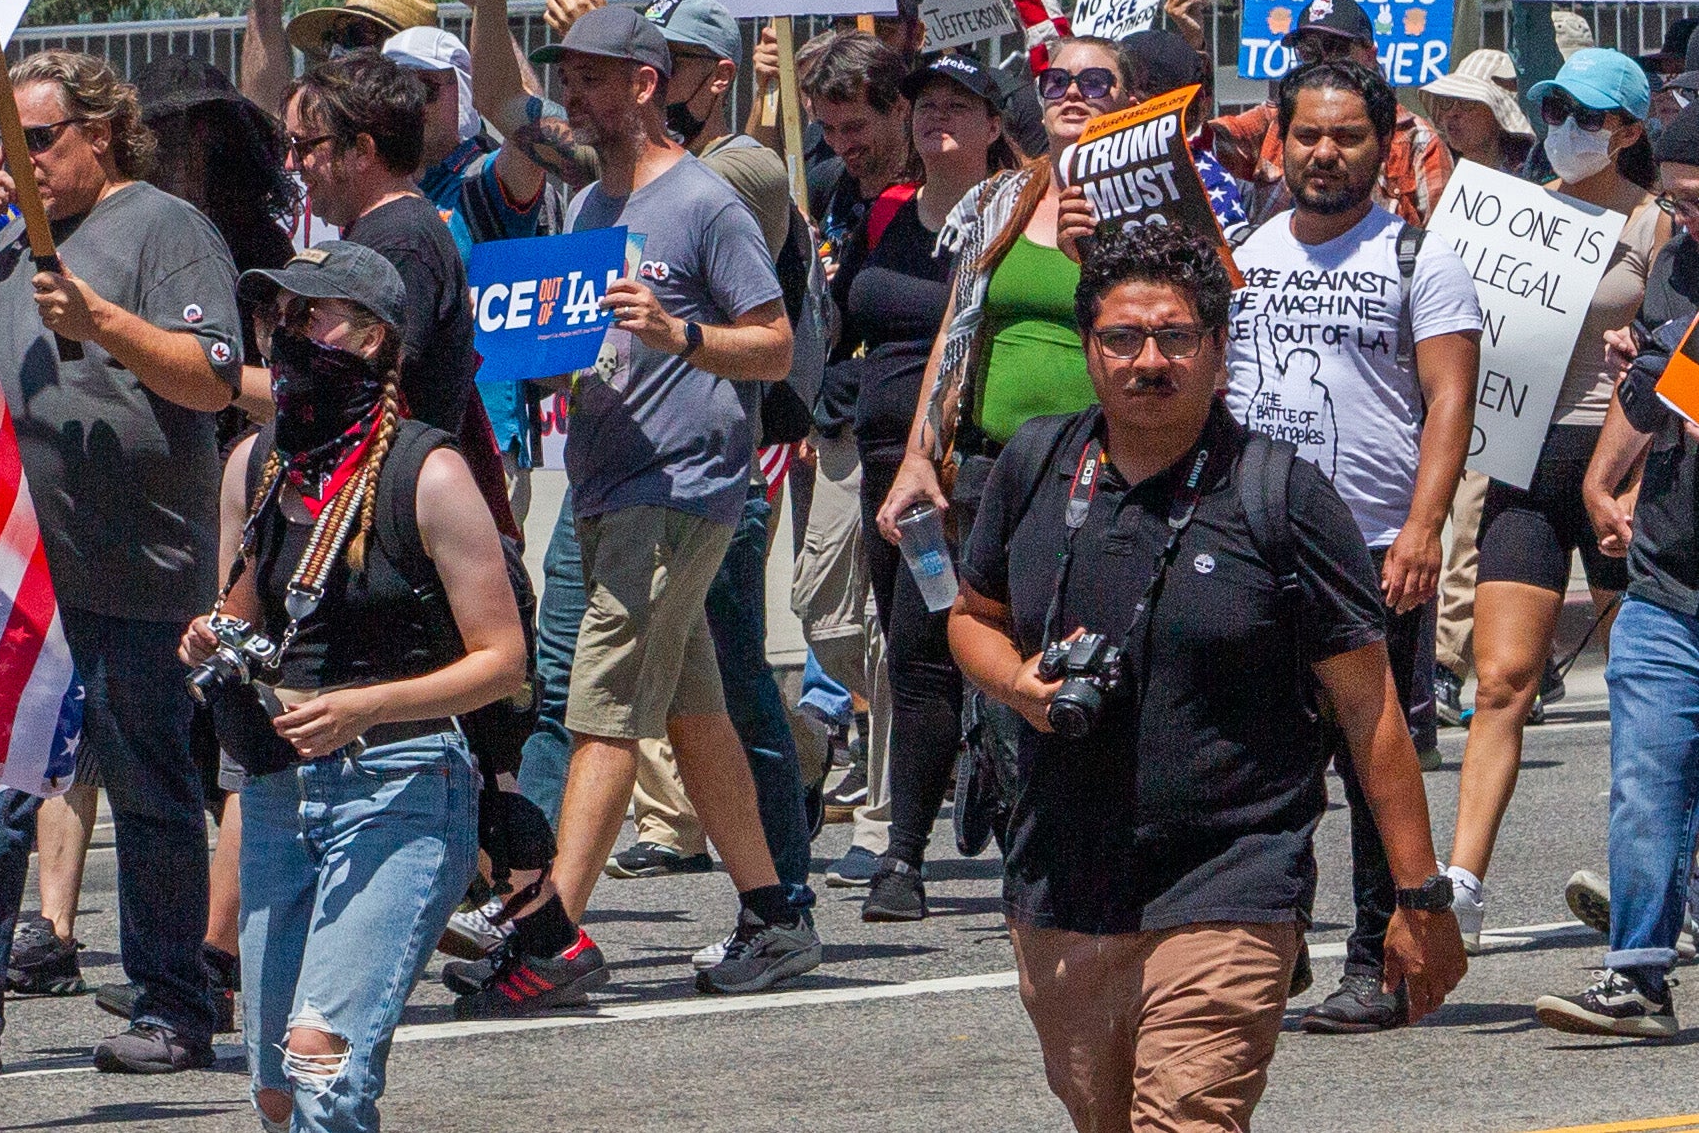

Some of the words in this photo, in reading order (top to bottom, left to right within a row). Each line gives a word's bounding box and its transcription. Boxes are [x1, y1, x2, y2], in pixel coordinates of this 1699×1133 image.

[1076, 114, 1177, 179] TRUMP
[1083, 161, 1182, 222] MUST
[1450, 184, 1502, 227] NO
[1508, 208, 1571, 252] ONE
[1573, 226, 1605, 264] IS
[538, 277, 564, 302] OUT
[1240, 267, 1281, 289] AGE
[1282, 269, 1398, 297] AGAINST
[537, 301, 556, 326] OF
[1264, 294, 1387, 322] MACHINE
[1273, 323, 1321, 345] OUT
[1321, 324, 1351, 347] OF
[1357, 326, 1389, 354] LA
[1261, 391, 1282, 407] THE
[1257, 405, 1298, 423] BATTLE
[1299, 410, 1319, 426] OF
[1276, 424, 1326, 445] Angeles
[1080, 458, 1096, 486] EOS
[1186, 449, 1209, 488] Canon
